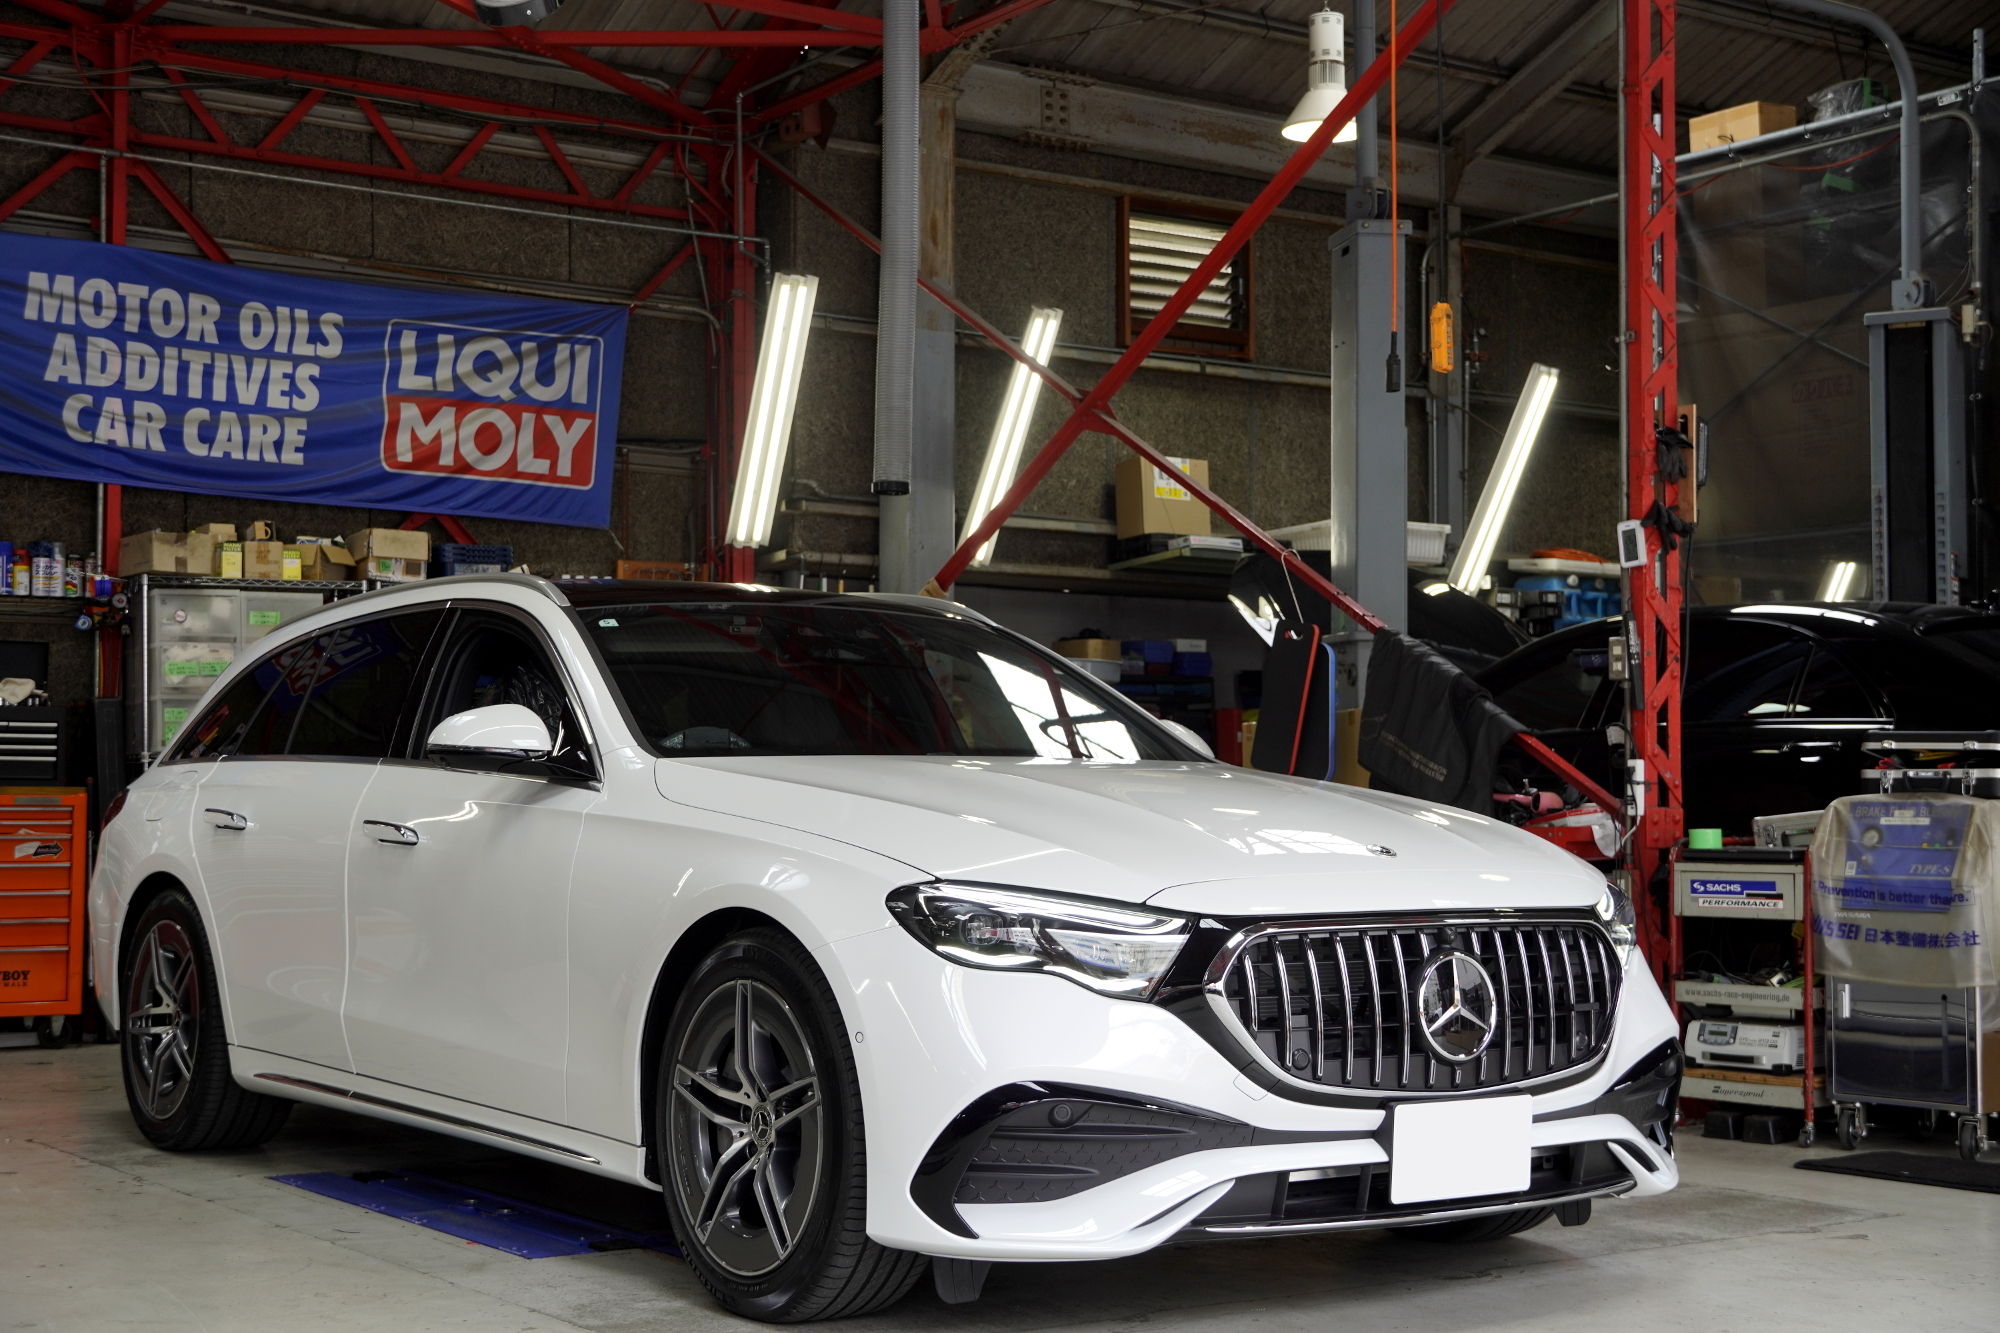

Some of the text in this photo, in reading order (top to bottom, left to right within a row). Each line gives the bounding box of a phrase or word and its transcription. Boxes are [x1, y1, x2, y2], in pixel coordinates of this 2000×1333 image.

[24, 271, 345, 360] MOTOR OILS
[44, 334, 321, 412] ADDITIVES
[398, 329, 593, 404] LIQUI
[62, 393, 308, 466] CAR CARE
[395, 402, 594, 478] MOLY
[1855, 806, 1886, 817] BRAKE
[1909, 864, 1952, 874] TYPE-S
[1706, 883, 1741, 892] SACHS
[1702, 899, 1780, 908] PERFORMANCE
[1888, 890, 1926, 904] better
[1865, 928, 1981, 948] 日本整備株会社
[0, 970, 31, 981] BOY
[1685, 988, 1790, 1003] www.sachs-race-engineering.de
